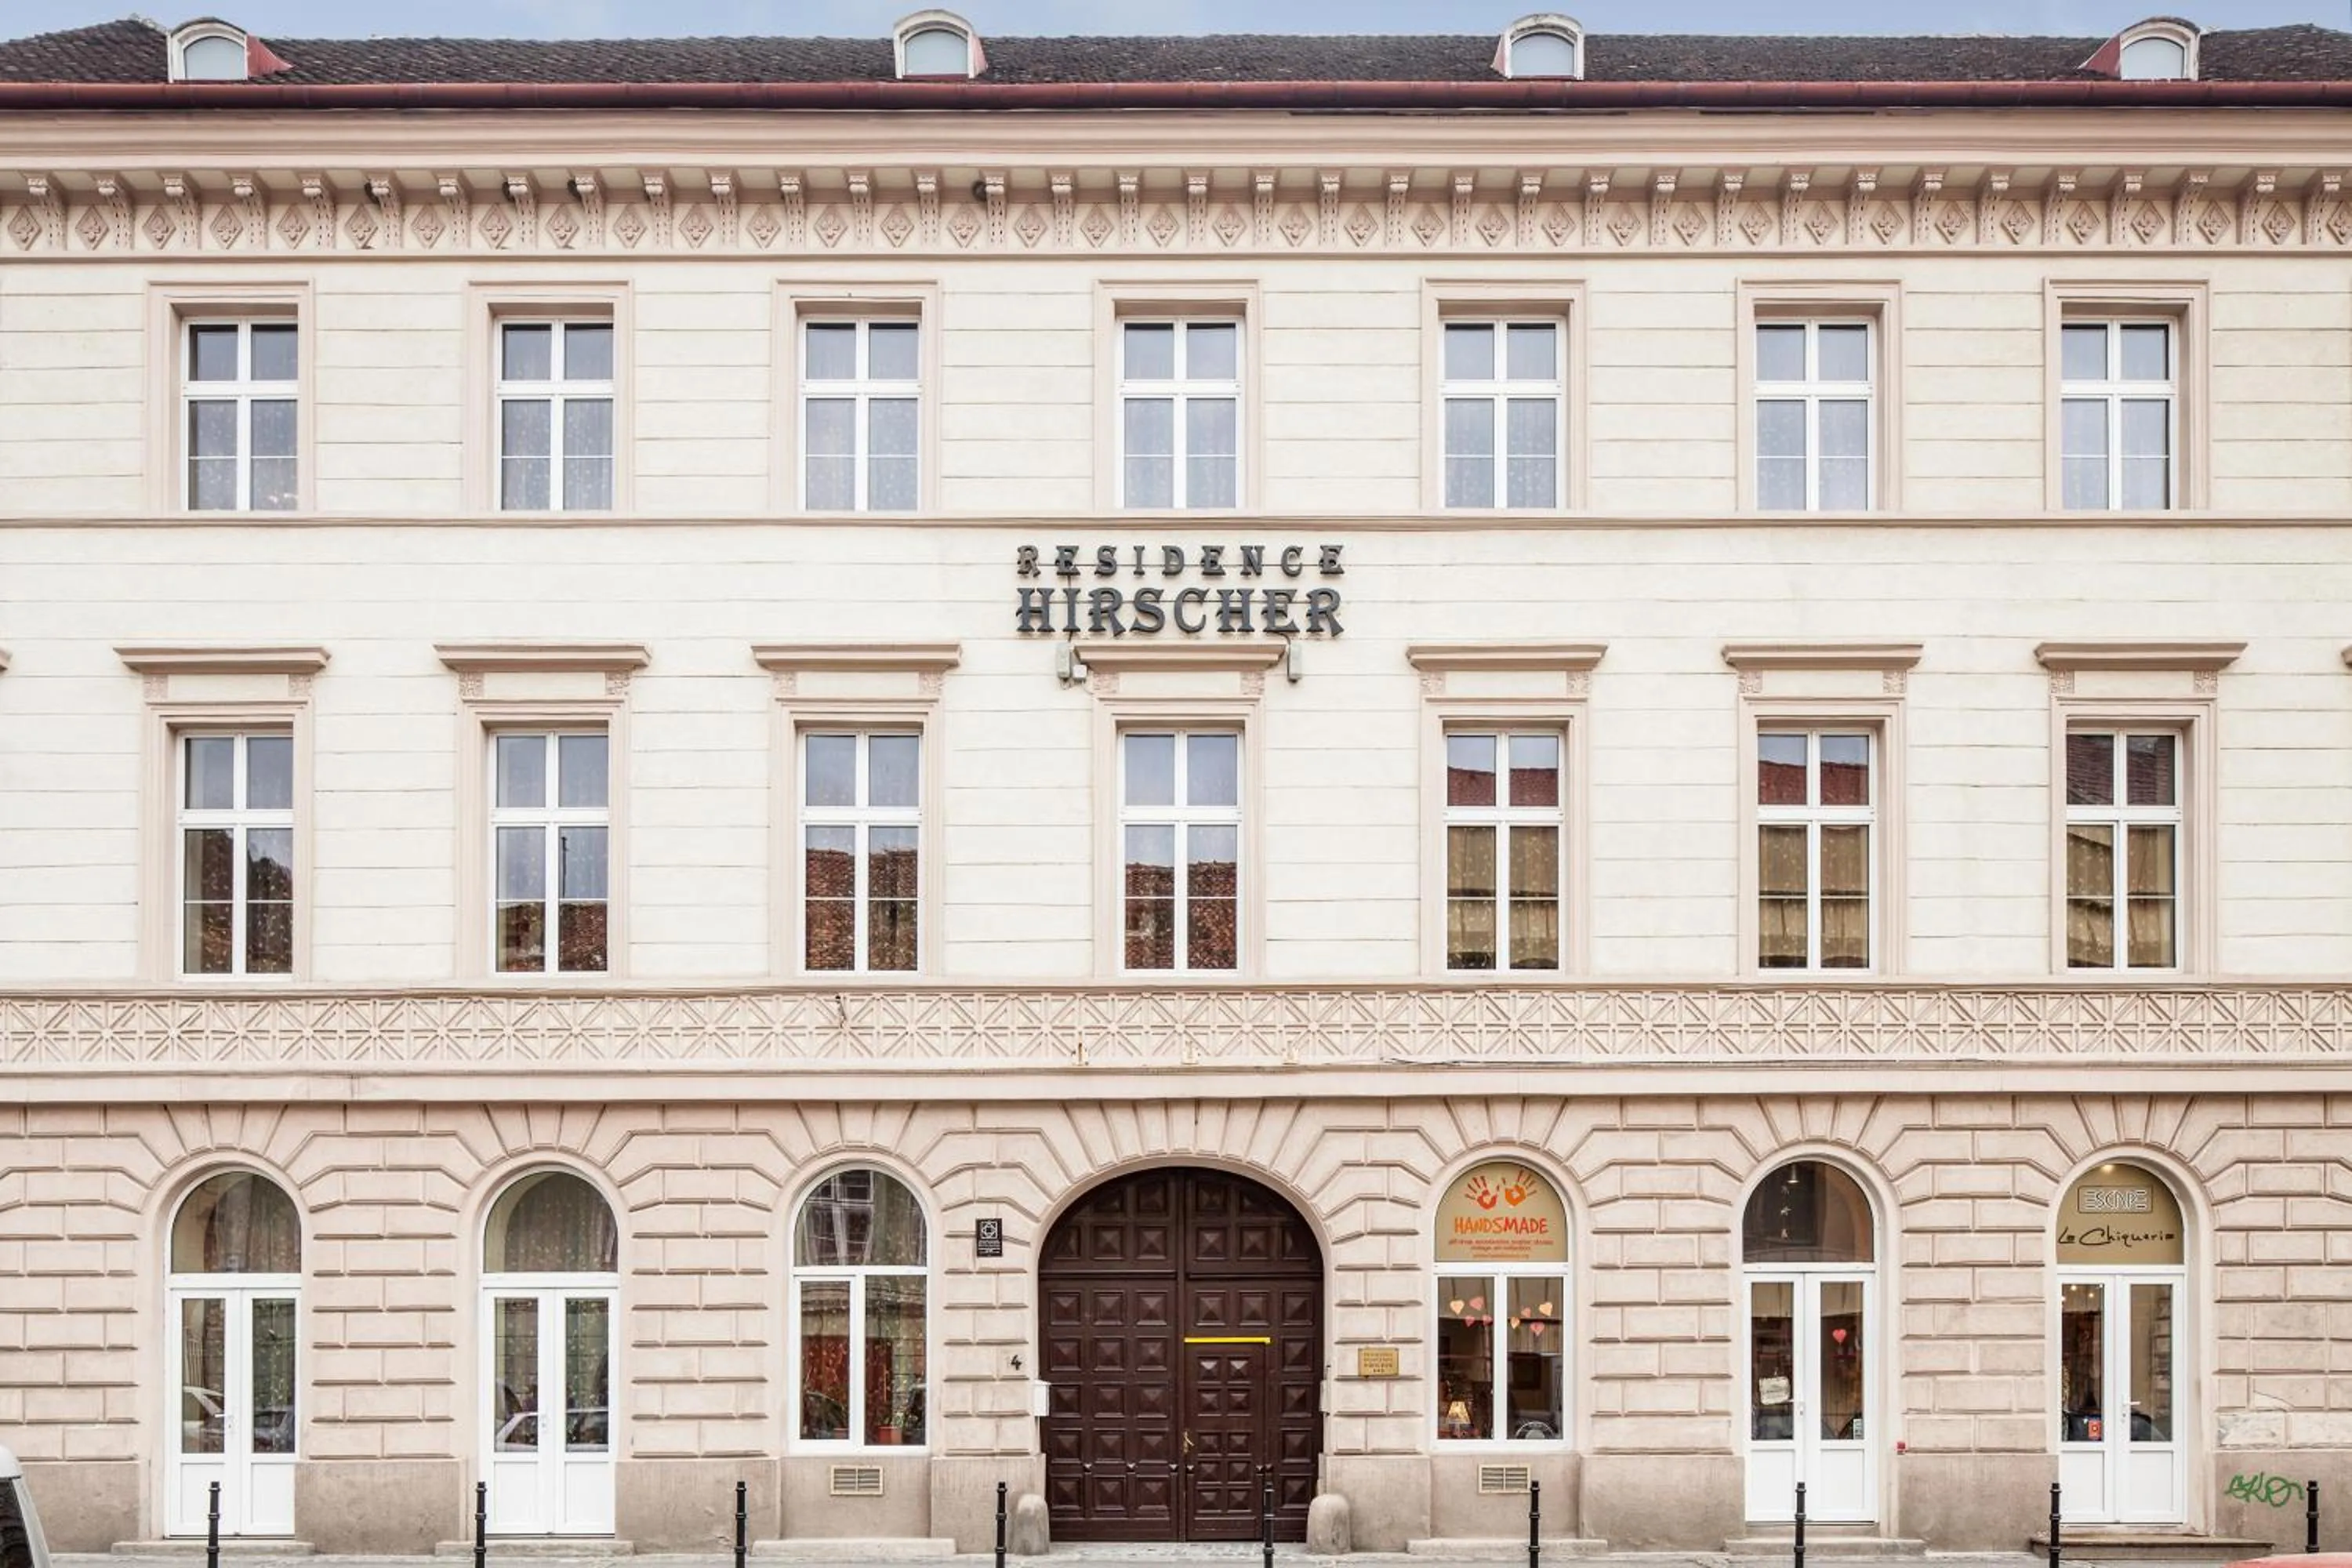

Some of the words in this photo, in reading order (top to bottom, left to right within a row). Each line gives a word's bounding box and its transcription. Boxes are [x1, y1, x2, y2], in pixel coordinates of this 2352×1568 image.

[1017, 545, 1345, 577] RESIDENCE
[1016, 587, 1343, 637] HIRSCHER
[1454, 1216, 1549, 1235] HANDSMADE
[1011, 1355, 1022, 1370] 4
